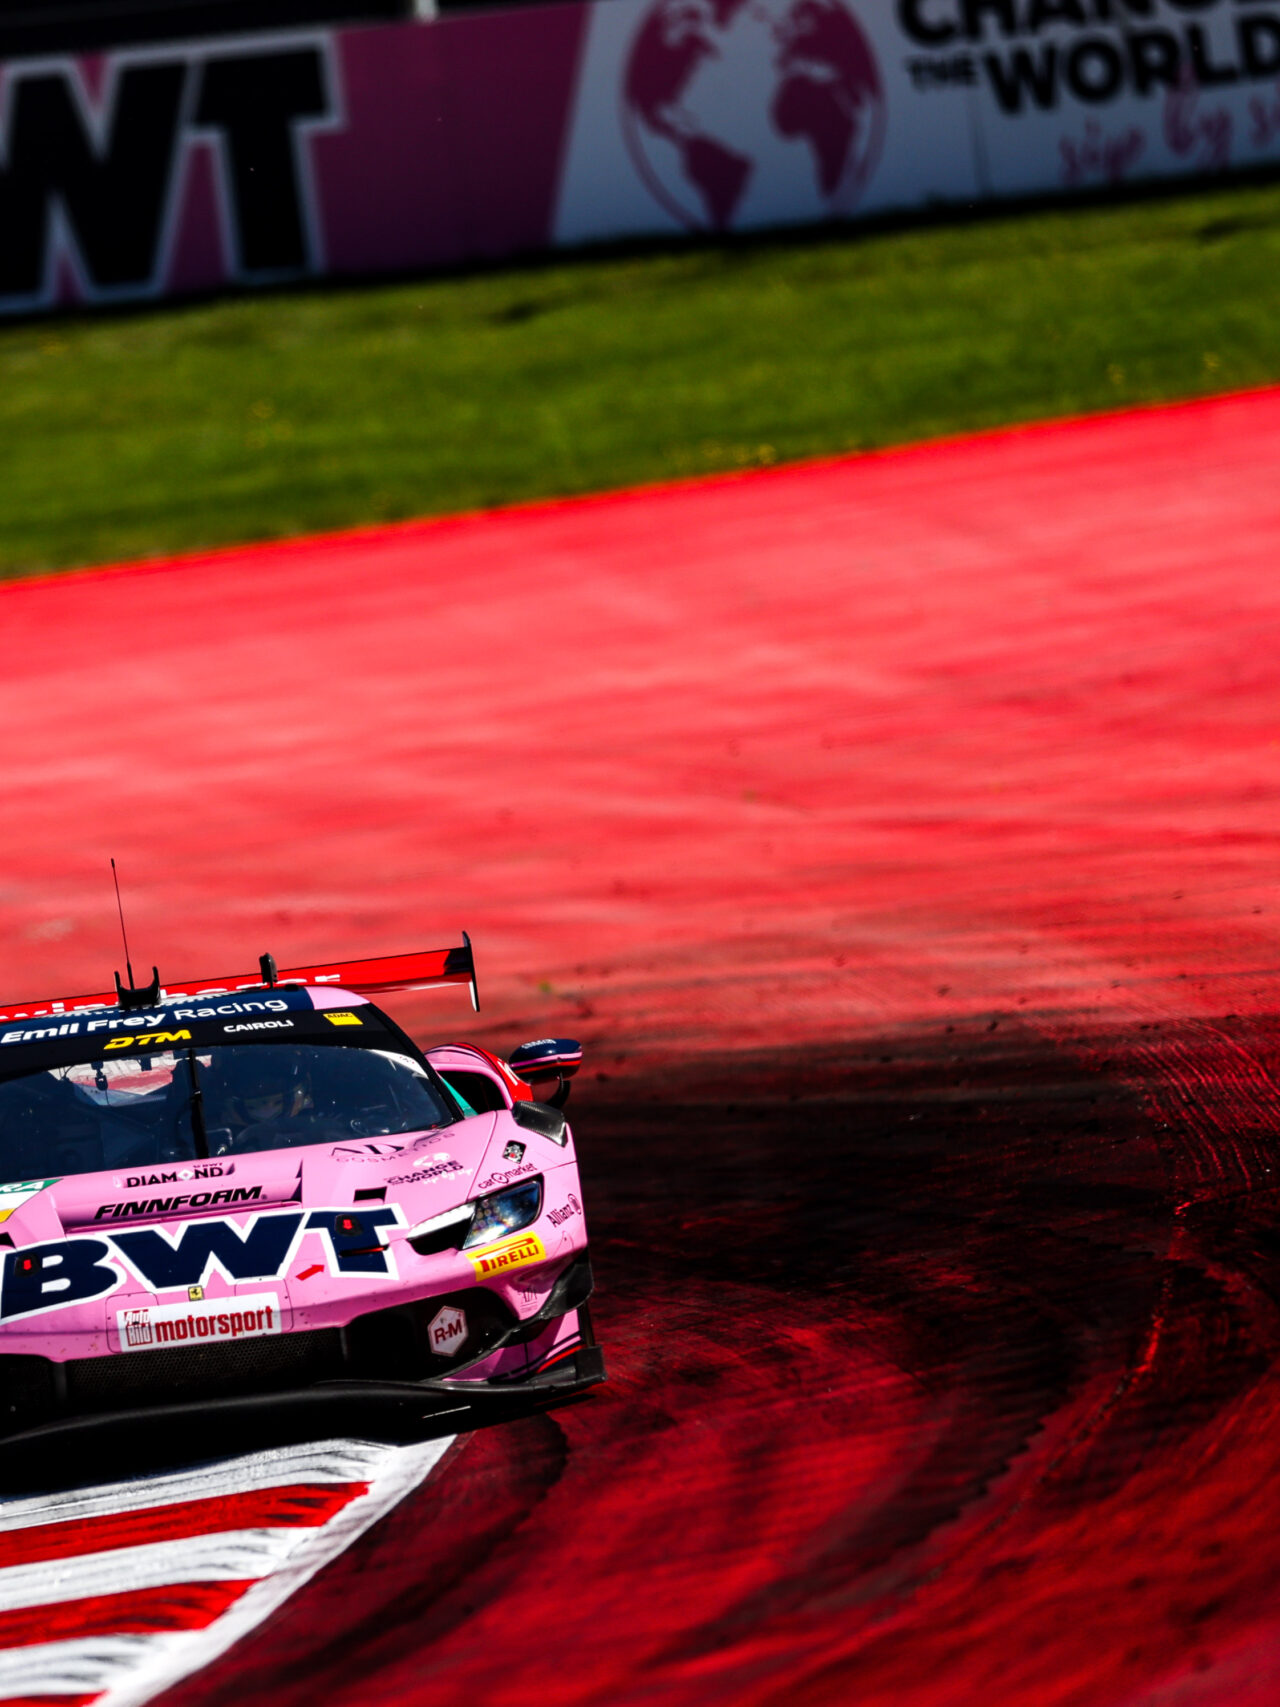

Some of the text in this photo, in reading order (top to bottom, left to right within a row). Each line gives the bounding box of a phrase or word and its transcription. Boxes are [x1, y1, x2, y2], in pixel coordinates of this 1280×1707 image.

[967, 15, 1280, 113] WORLD
[0, 999, 289, 1044] Emil Frey Racing
[223, 1019, 295, 1033] CAIROLI
[103, 1029, 192, 1050] DTM
[93, 1185, 263, 1220] FINNFOAM
[546, 1203, 575, 1228] Allianz
[475, 1237, 540, 1273] PIRELLI
[155, 1305, 273, 1343] motorsport
[433, 1318, 463, 1344] R-M
